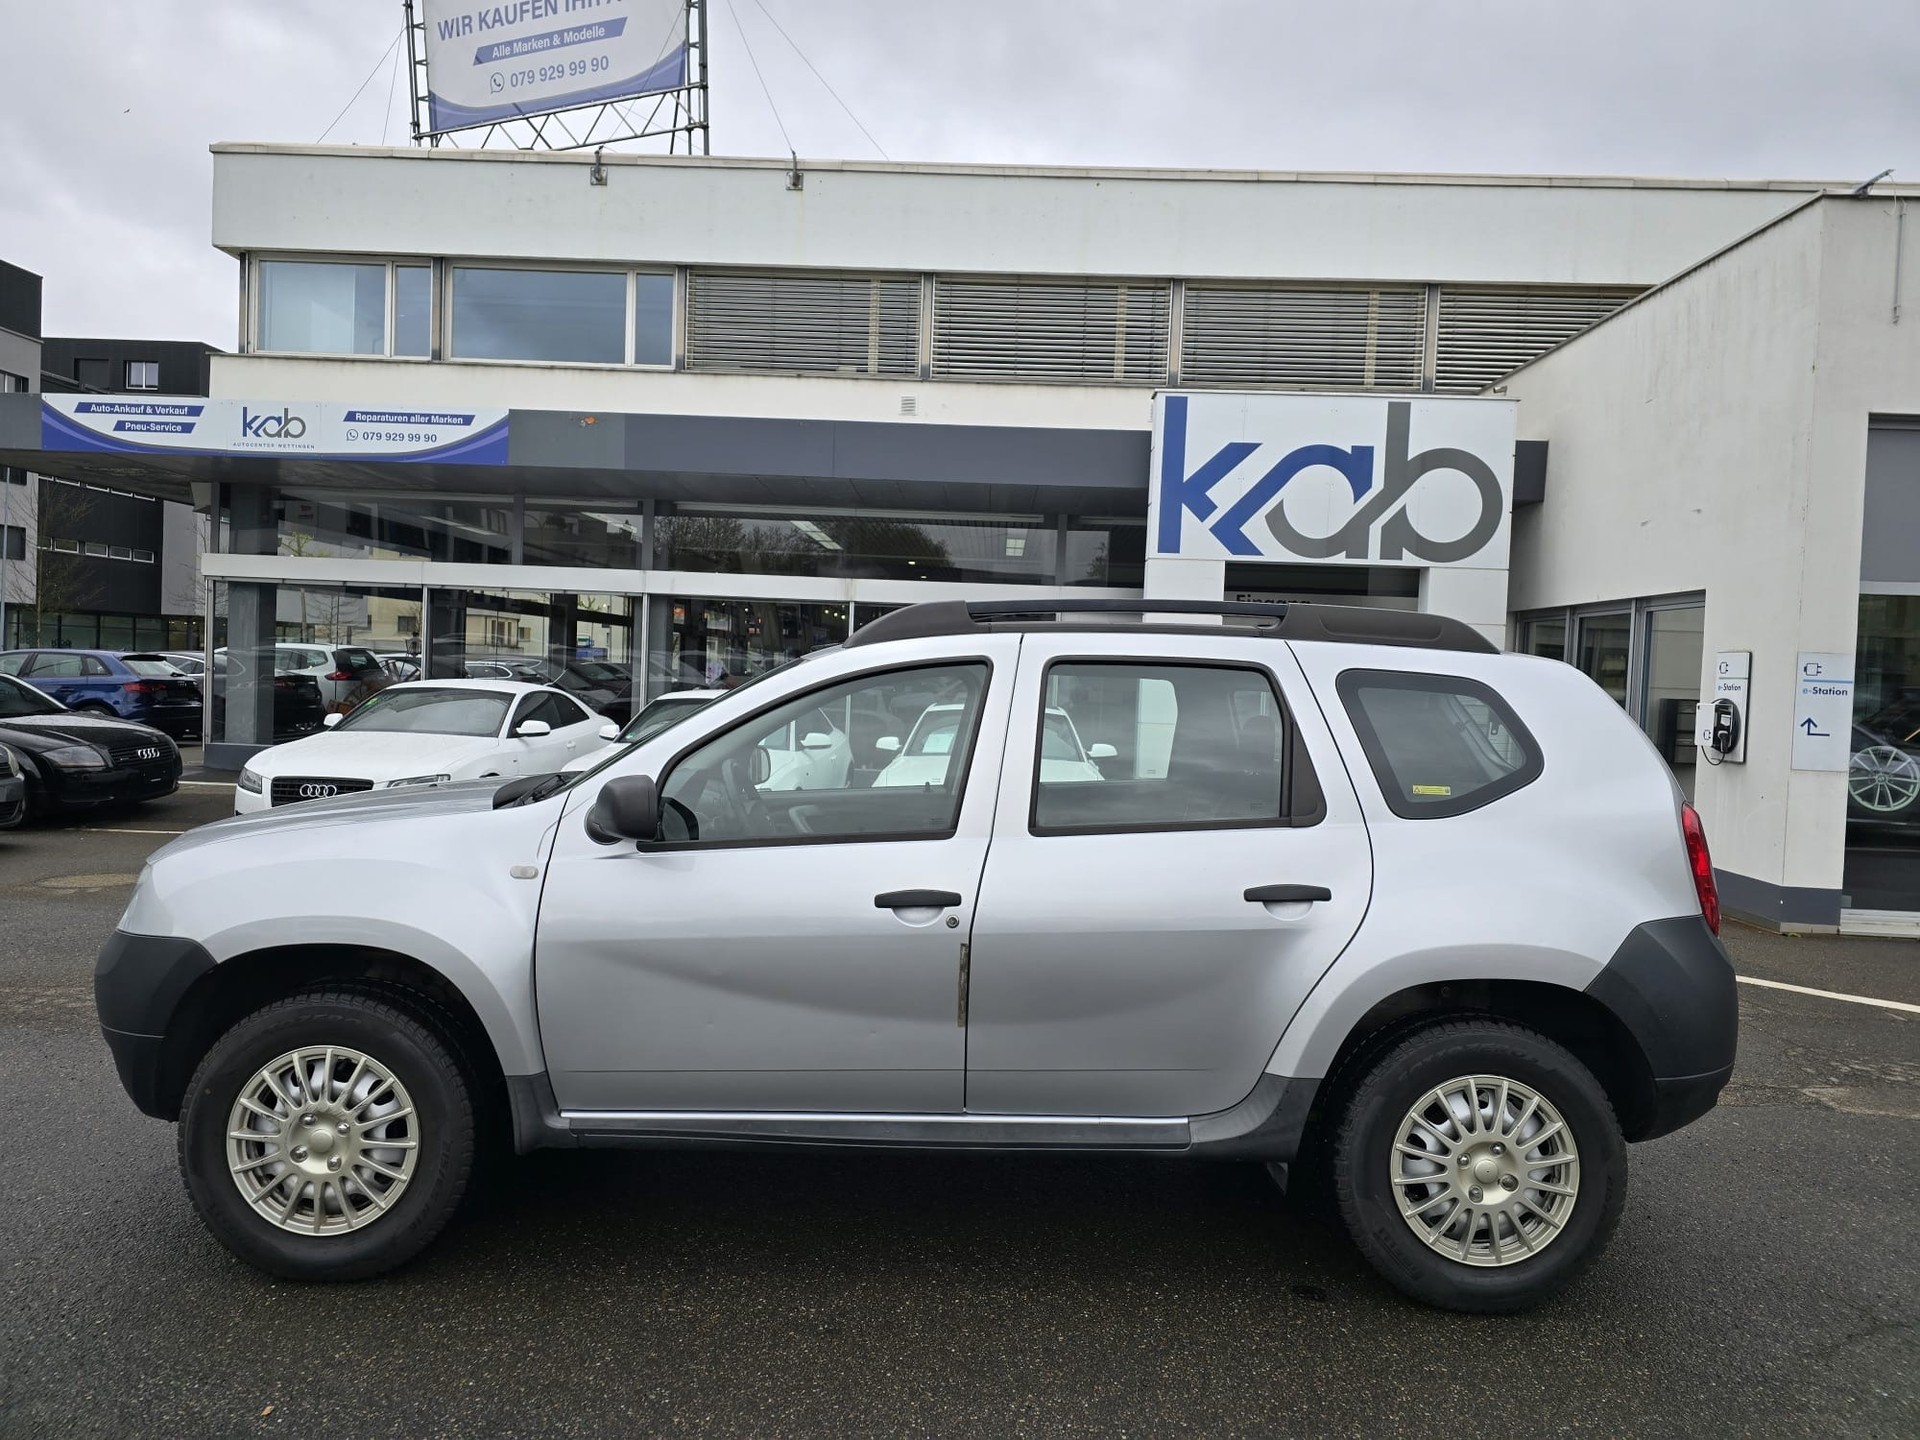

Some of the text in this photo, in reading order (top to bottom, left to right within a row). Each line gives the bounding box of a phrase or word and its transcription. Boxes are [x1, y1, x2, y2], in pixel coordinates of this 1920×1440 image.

[437, 14, 473, 41] WIR
[478, 0, 558, 32] KAUFEN
[492, 25, 606, 58] Alle Marken & Modelle
[510, 55, 609, 88] 079 929 99 90
[90, 404, 188, 416] Auto-Ankauf & Verkauf
[242, 406, 307, 439] kab
[355, 412, 463, 425] Reparaturen aller Marken
[125, 422, 182, 432] Pneu-Service
[362, 431, 437, 443] 079 929 99 90
[1157, 395, 1504, 563] kab
[1717, 682, 1742, 692] e-Station
[1802, 686, 1848, 697] e-Station
